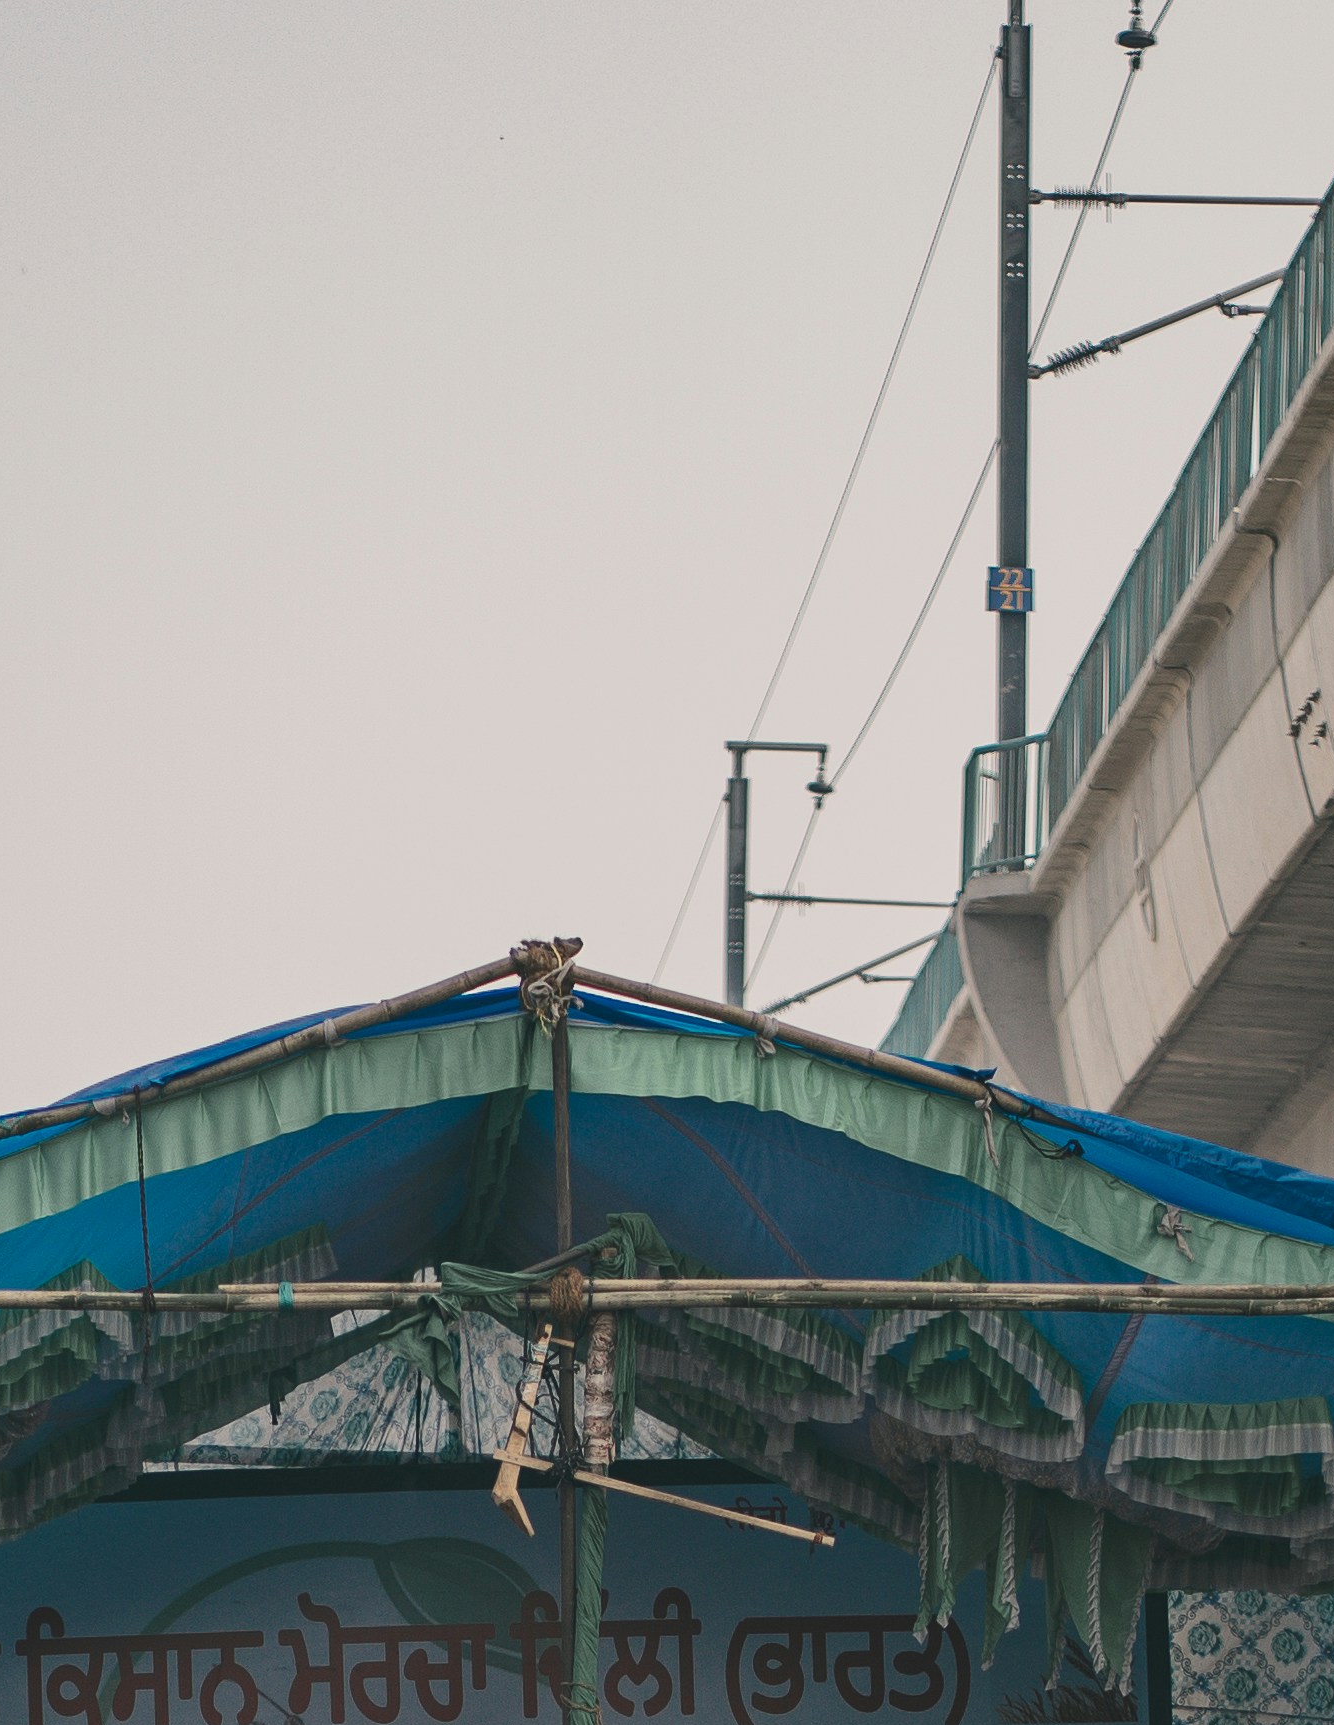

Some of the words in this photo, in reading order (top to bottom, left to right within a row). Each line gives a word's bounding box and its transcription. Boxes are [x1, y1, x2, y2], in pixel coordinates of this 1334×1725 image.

[998, 568, 1025, 588] 22
[1000, 591, 1024, 610] 21
[277, 1592, 496, 1725] ਮੋਰਚਾ
[509, 1586, 702, 1719] ਿਲੀ
